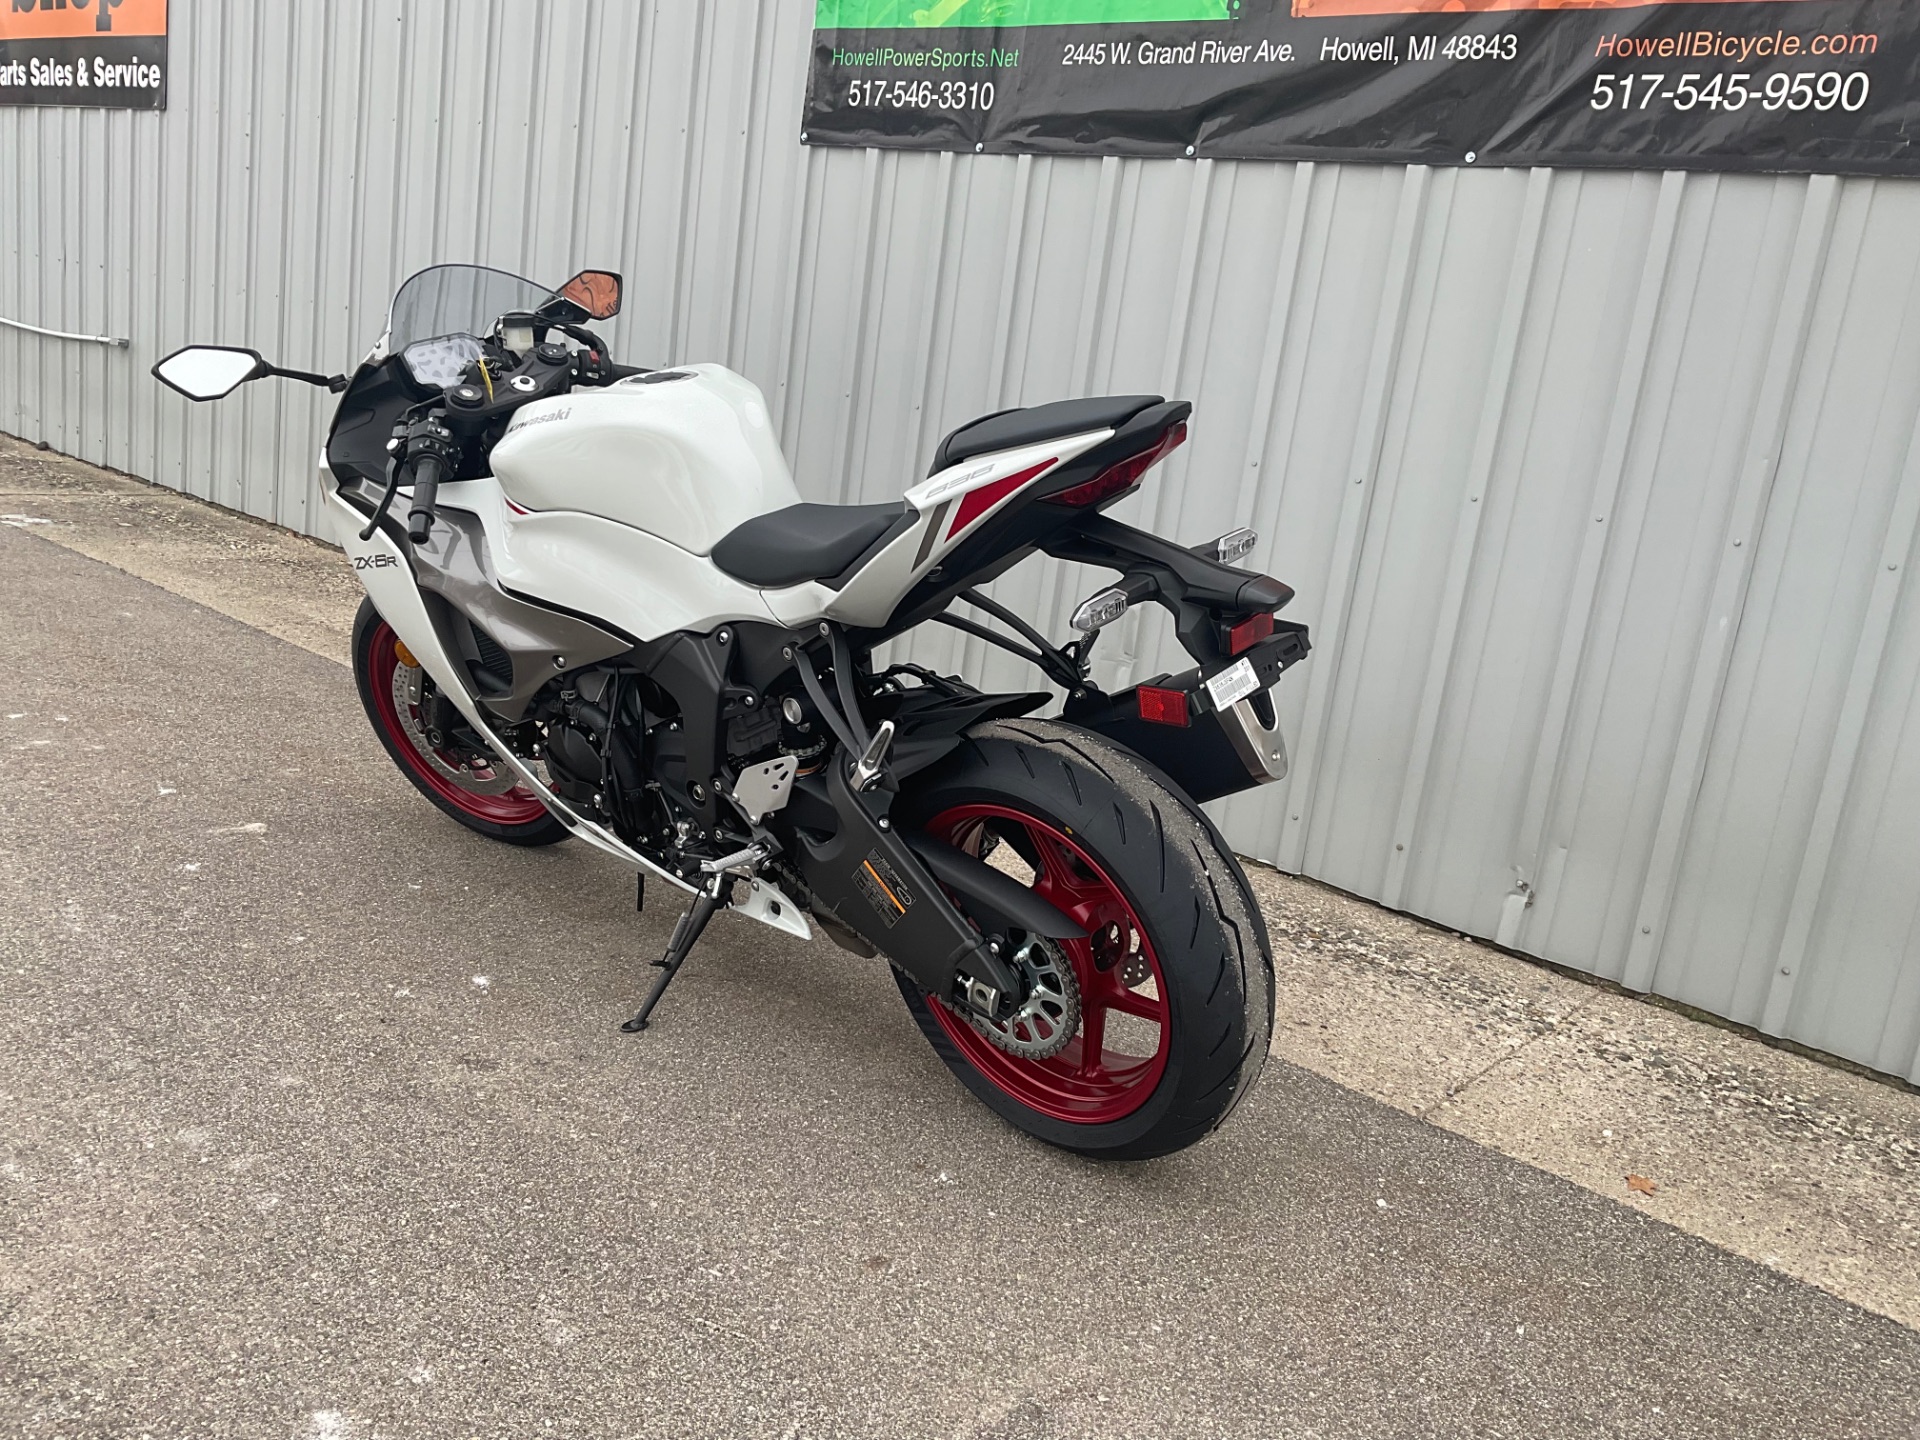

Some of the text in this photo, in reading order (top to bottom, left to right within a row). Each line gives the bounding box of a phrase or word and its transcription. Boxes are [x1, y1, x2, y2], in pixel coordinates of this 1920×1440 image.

[832, 48, 1020, 71] HowellPowerSports.Net
[1062, 39, 1296, 65] 2445 W. Grand River Ave.
[1319, 34, 1518, 65] Howell, MI 48843
[1594, 30, 1879, 63] HowellBicycle.com
[30, 57, 73, 87] Sales
[77, 57, 90, 87] &
[93, 56, 161, 88] Service
[848, 80, 995, 110] 517-546-3310
[1590, 71, 1870, 111] 517-545-9590
[354, 554, 398, 570] ZX-6R
